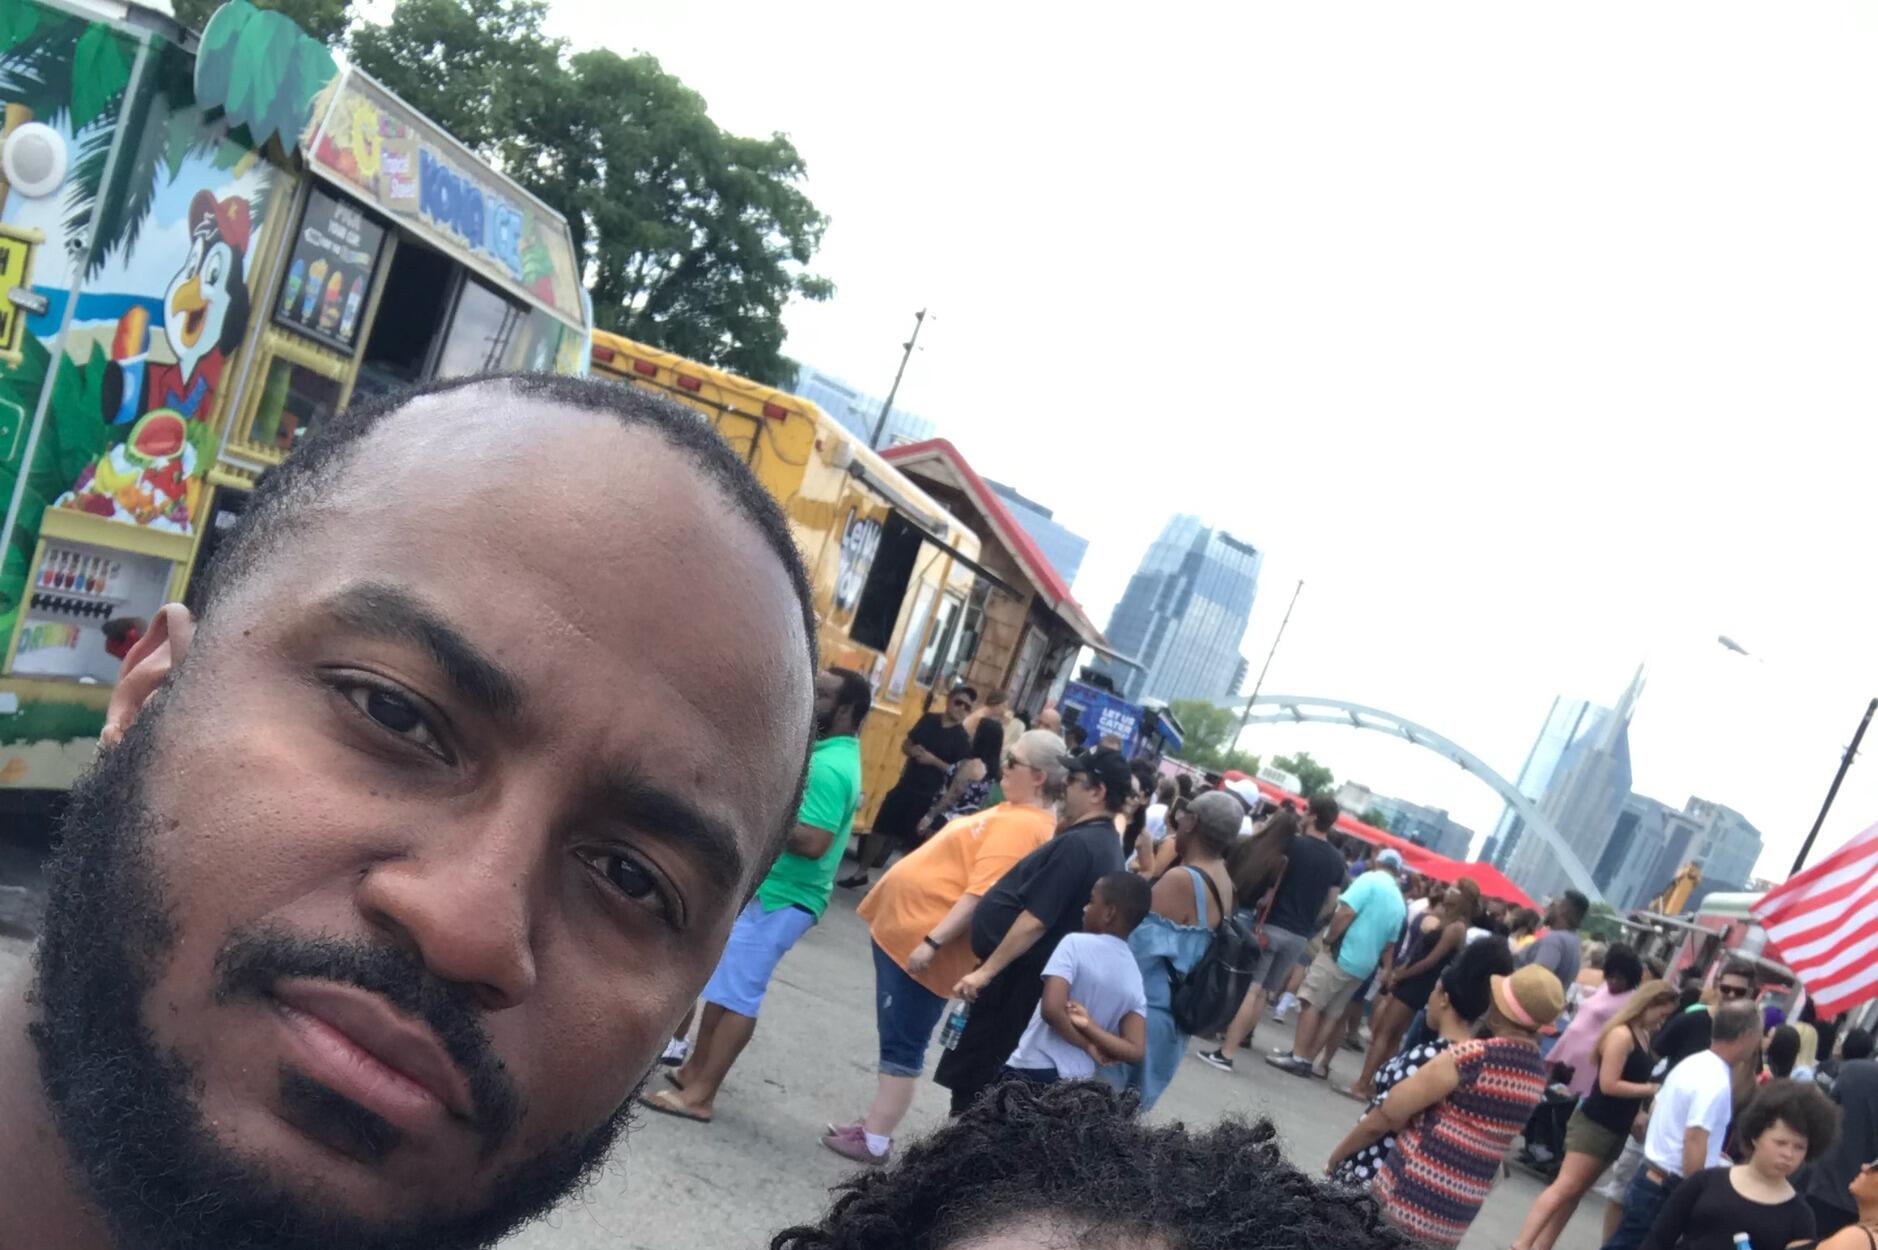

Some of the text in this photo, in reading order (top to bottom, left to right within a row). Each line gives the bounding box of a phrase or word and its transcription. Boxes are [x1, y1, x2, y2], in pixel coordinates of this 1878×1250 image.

[418, 146, 485, 251] KONA
[484, 195, 524, 281] ICE
[1098, 716, 1133, 734] CATER
[1102, 707, 1136, 727] LET US
